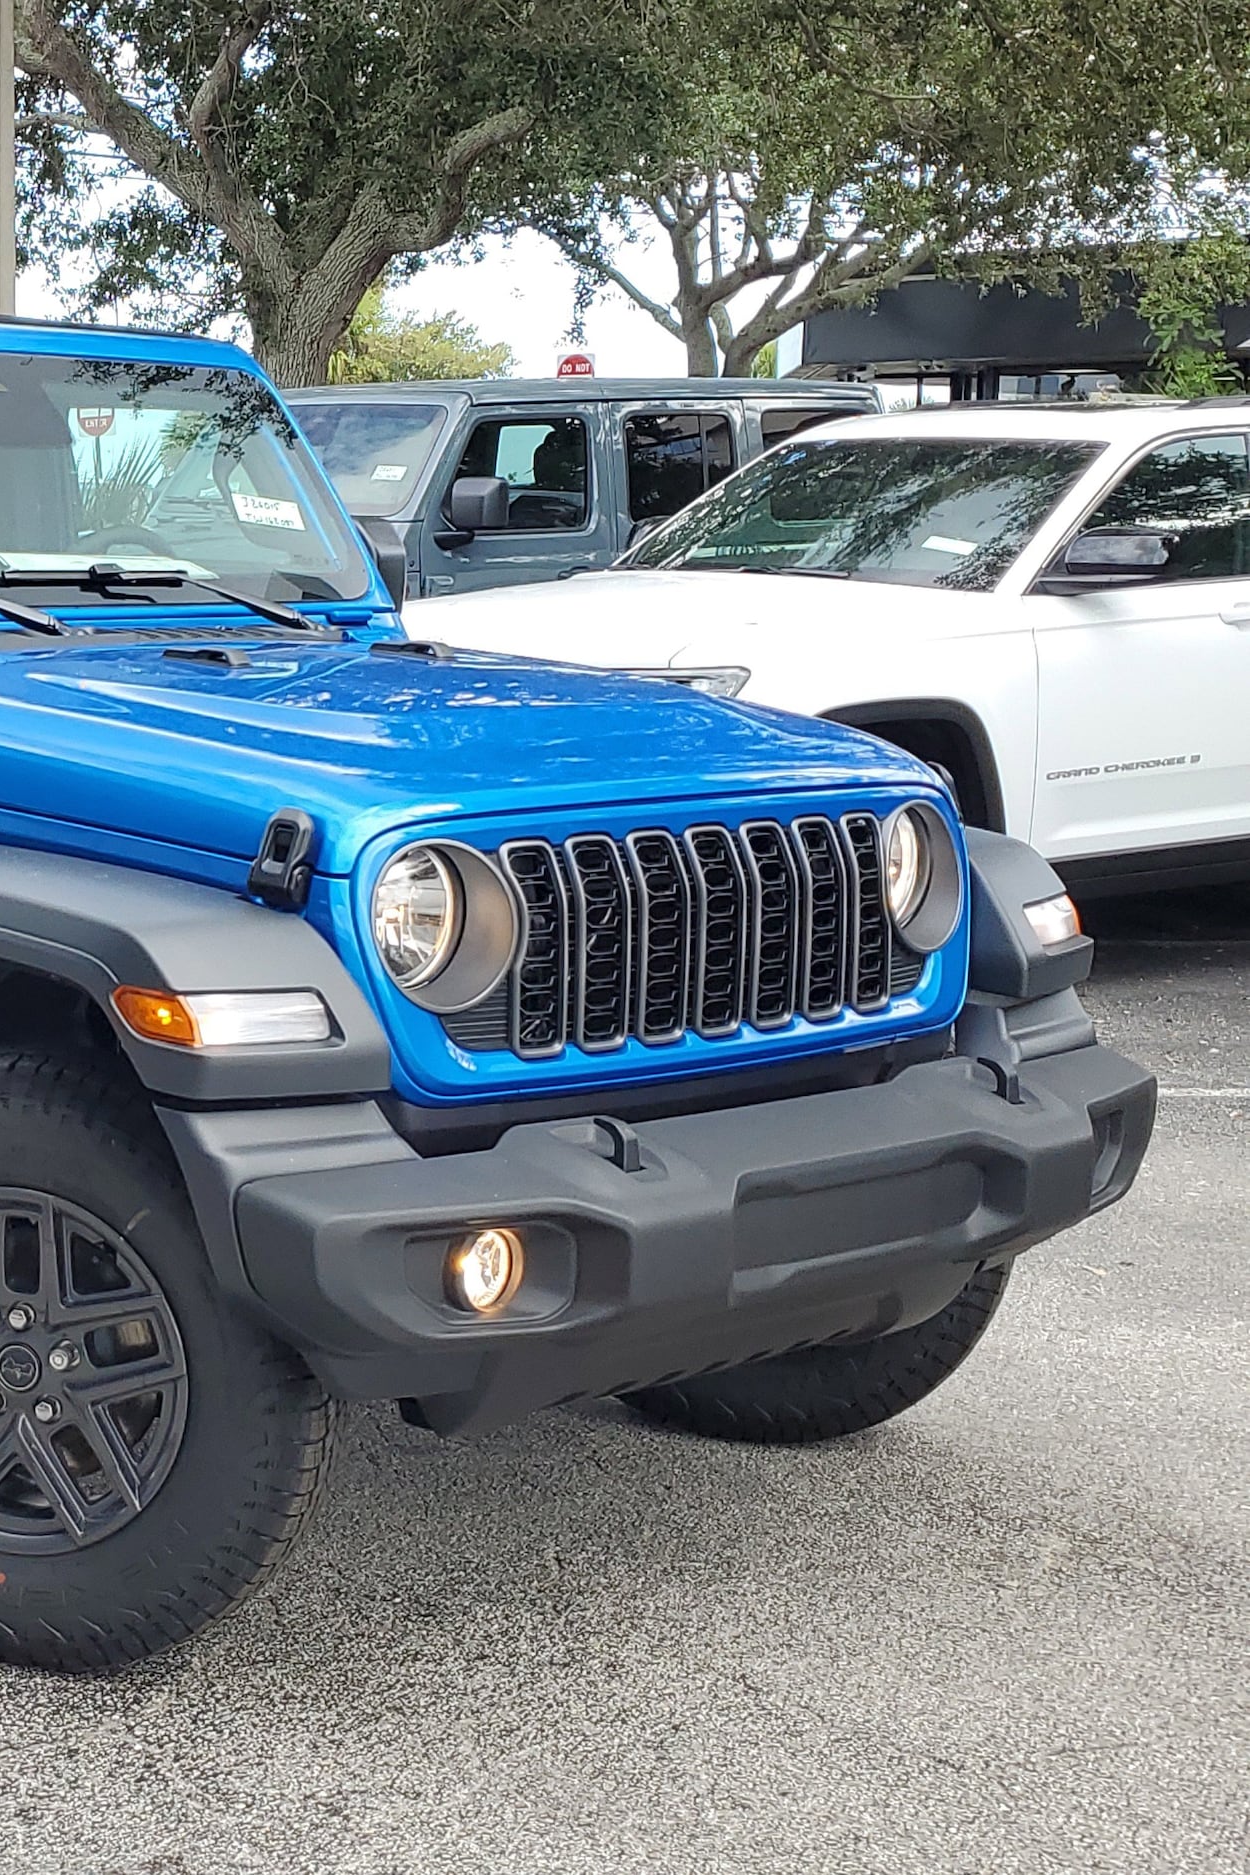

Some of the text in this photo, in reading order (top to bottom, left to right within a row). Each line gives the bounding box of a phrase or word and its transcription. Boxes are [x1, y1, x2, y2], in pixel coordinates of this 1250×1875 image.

[561, 362, 590, 374] DO NOT
[1046, 755, 1187, 781] GRAND CHEROKEE
